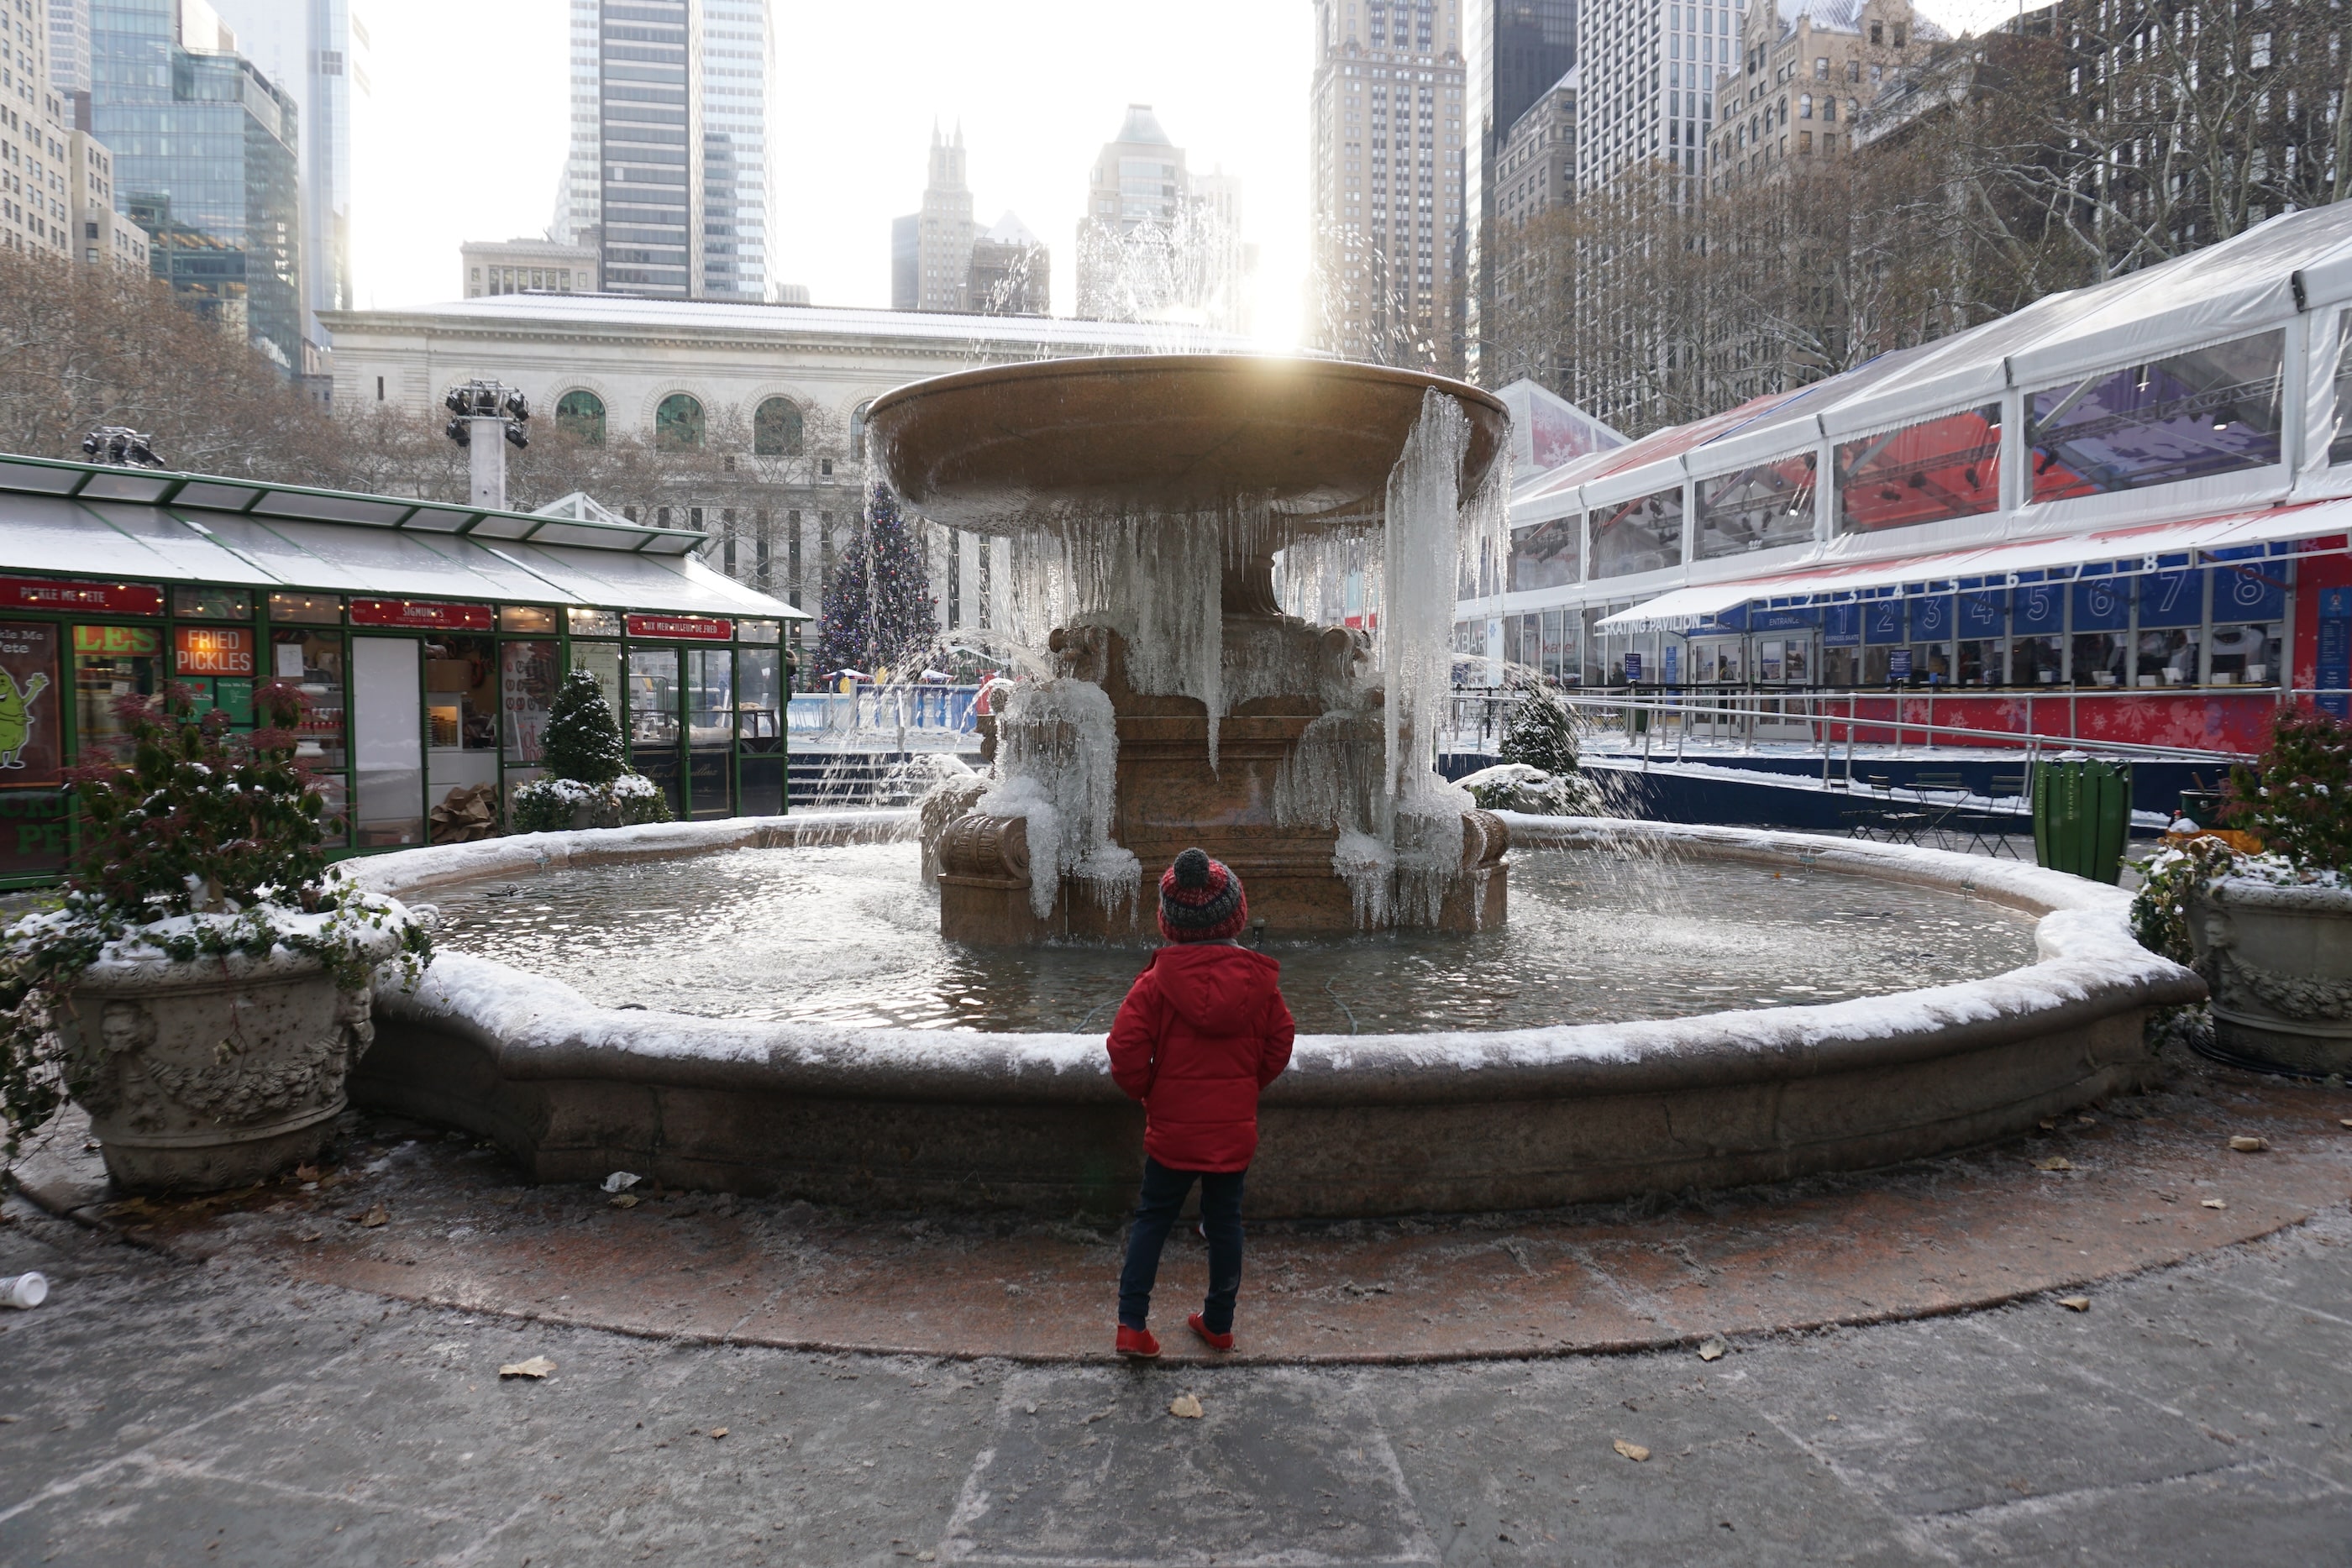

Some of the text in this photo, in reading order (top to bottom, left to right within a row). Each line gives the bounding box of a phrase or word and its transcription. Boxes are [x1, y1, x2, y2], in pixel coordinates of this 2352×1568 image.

[20, 587, 58, 600] PIKLE
[61, 590, 76, 601] ME
[1807, 591, 1814, 606] 2
[1848, 586, 1858, 604] 3
[1893, 582, 1904, 600] 4
[1948, 577, 1960, 594] 5
[2006, 569, 2020, 588] 6
[2070, 560, 2085, 581] 7
[2143, 551, 2159, 573] 8
[2159, 570, 2187, 612] 7
[2234, 562, 2265, 606] 8
[403, 606, 444, 617] SIGMUN'S
[1923, 595, 1941, 629] 3
[1971, 590, 1994, 625] 4
[2027, 585, 2050, 621] 5
[2089, 577, 2115, 616] 6
[657, 622, 694, 632] MEREILLEUX
[1604, 613, 1701, 636] SKATING PAVILION
[1877, 600, 1894, 632] 2
[22, 630, 45, 640] Me
[187, 630, 239, 649] FRIED
[176, 651, 251, 671] PICKLES
